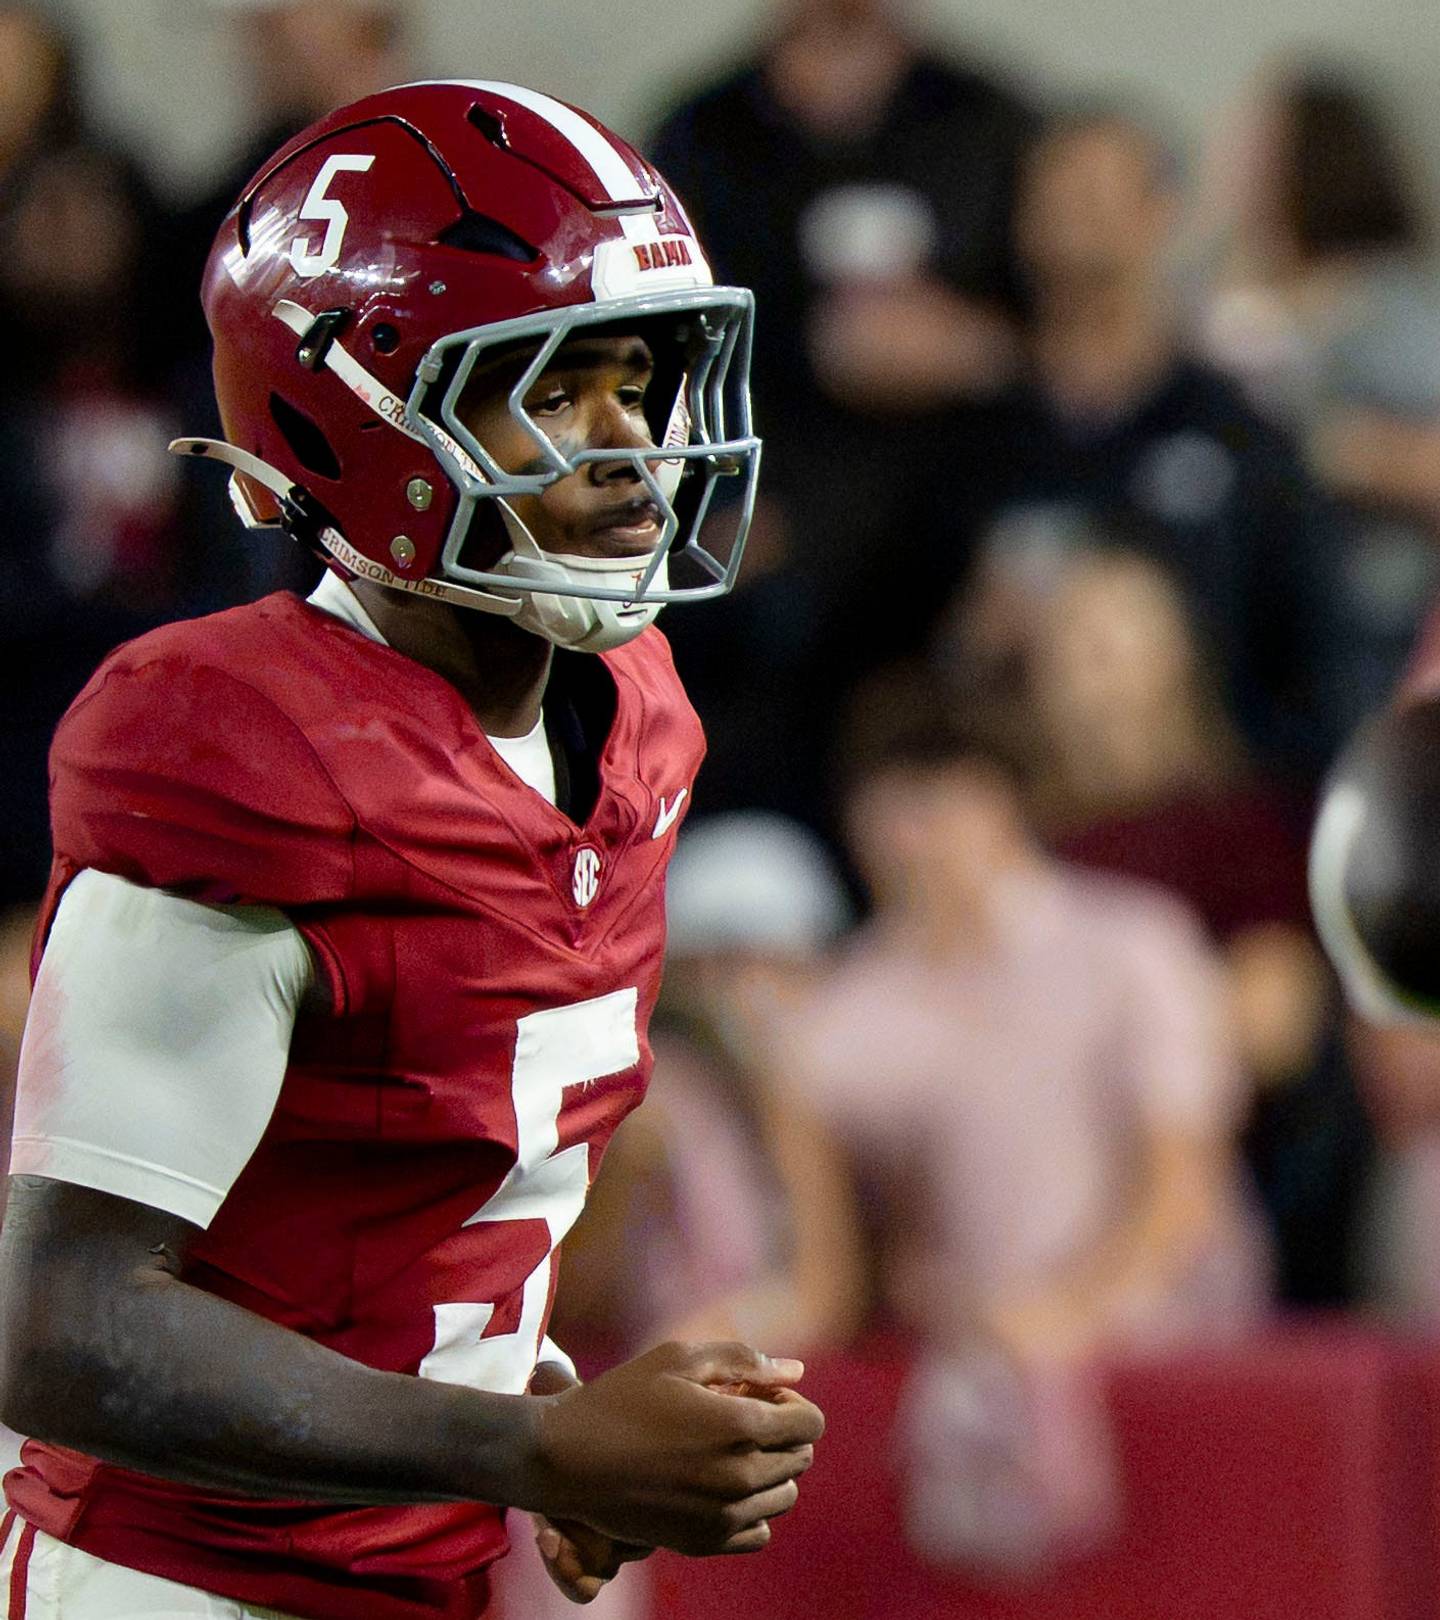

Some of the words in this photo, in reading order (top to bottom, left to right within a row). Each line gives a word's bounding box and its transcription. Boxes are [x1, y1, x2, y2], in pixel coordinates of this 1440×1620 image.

[291, 154, 376, 278] 5
[321, 526, 395, 585] CRIMSON
[573, 848, 601, 907] SEC
[418, 986, 640, 1396] 5
